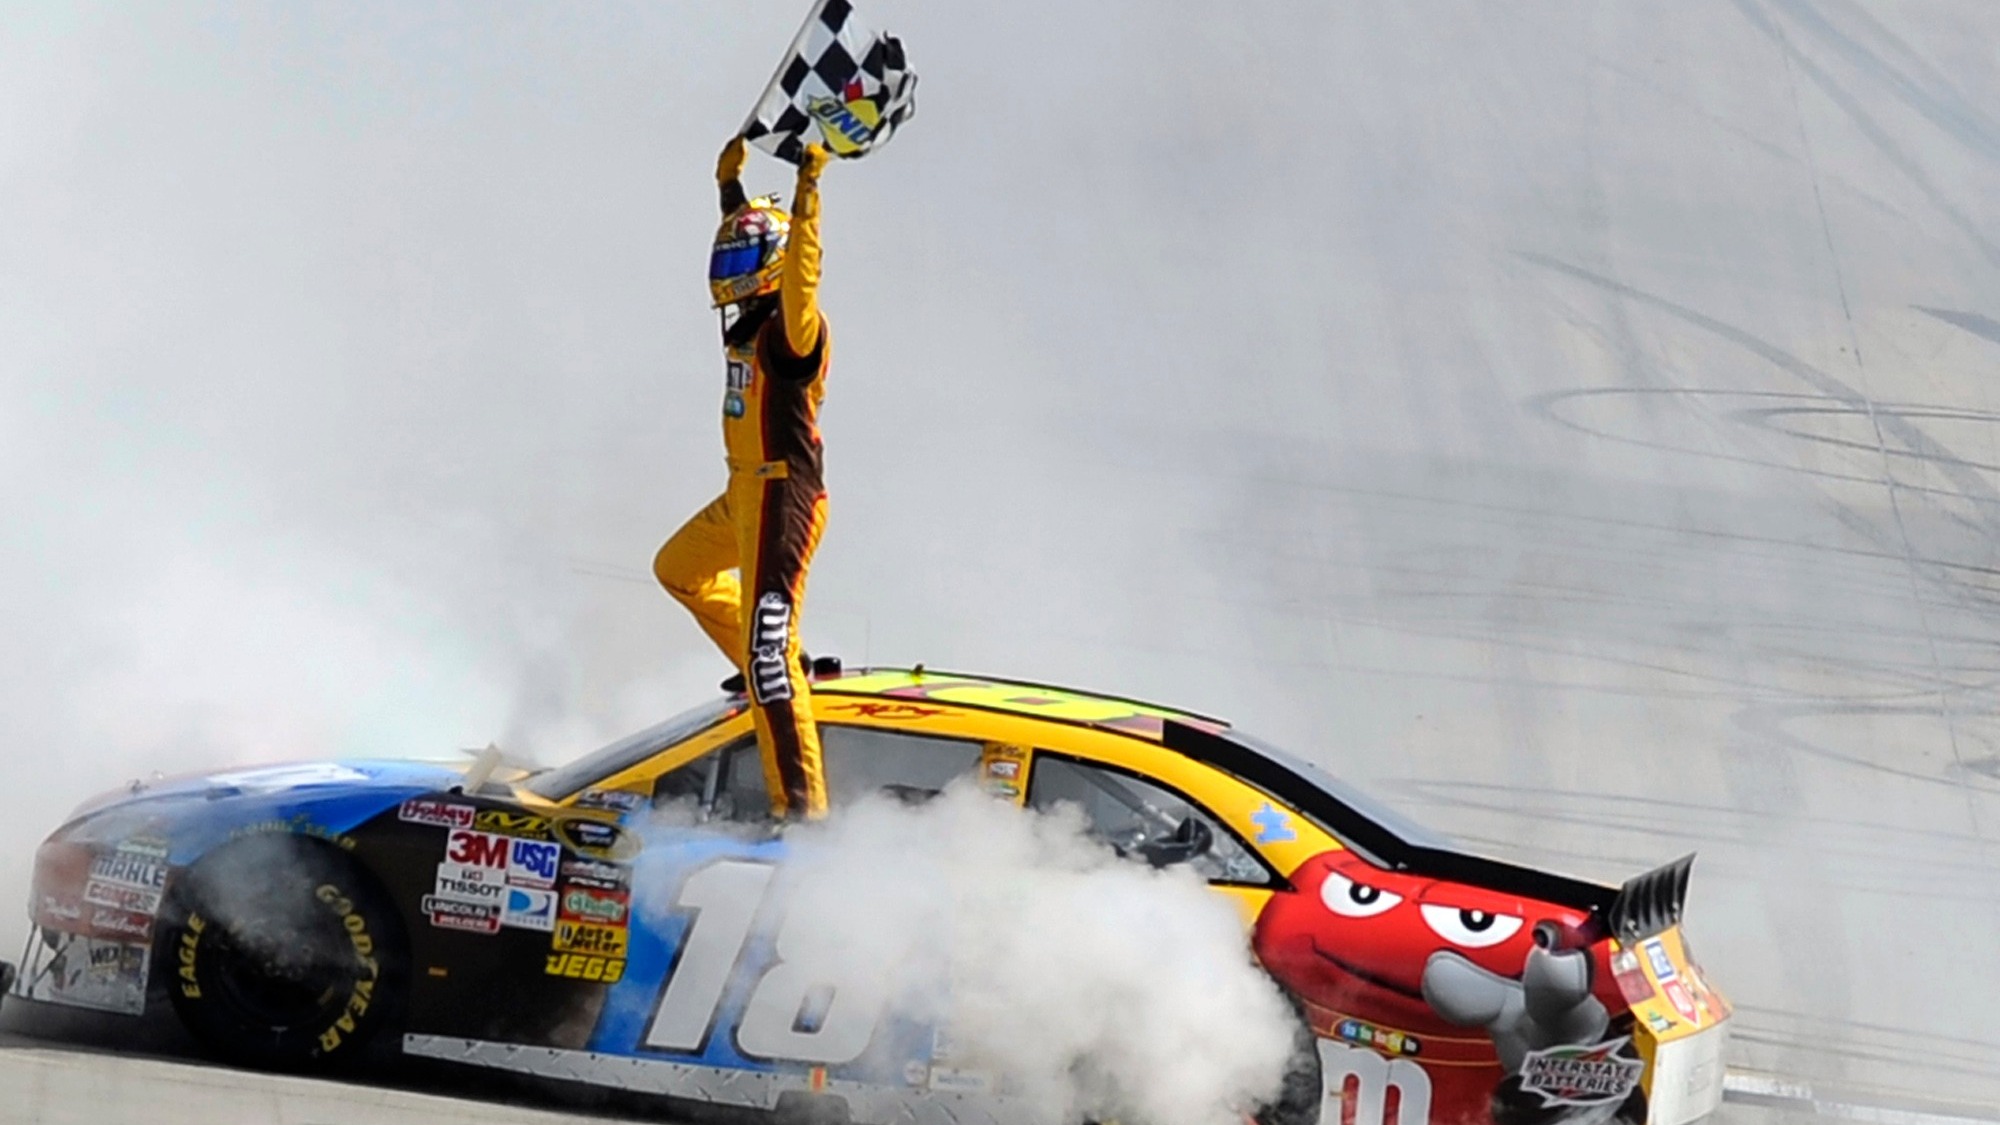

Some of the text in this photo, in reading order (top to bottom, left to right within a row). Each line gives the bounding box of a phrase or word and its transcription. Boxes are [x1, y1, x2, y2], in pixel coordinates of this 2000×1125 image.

[449, 831, 509, 870] 3M
[512, 840, 557, 879] USG
[95, 858, 166, 887] MAHLE
[439, 878, 503, 898] TISSOT
[427, 899, 488, 917] LINCOLN
[178, 912, 206, 998] EAGLE
[545, 953, 625, 983] JEGS
[1528, 1055, 1638, 1081] INTERSTATE
[1530, 1072, 1628, 1095] BATTERIES
